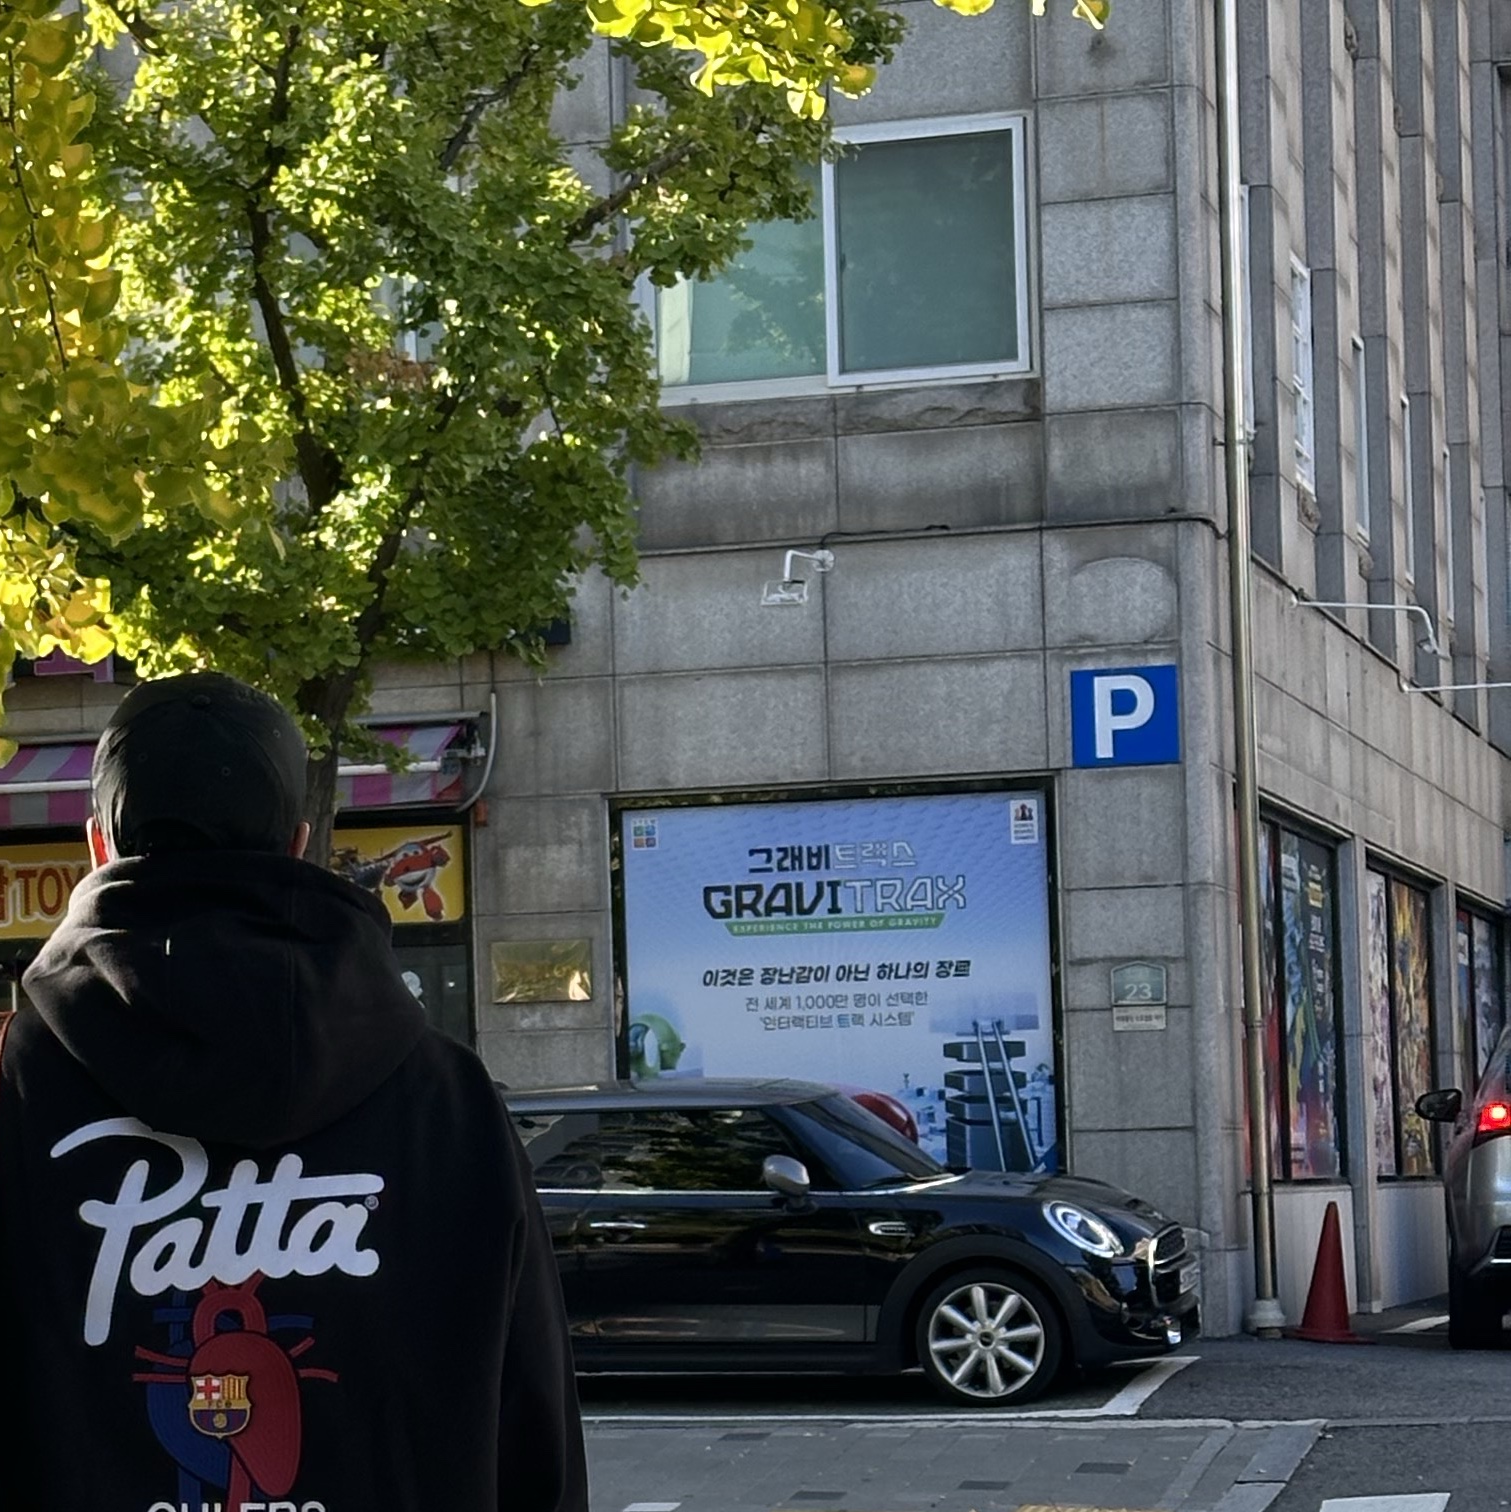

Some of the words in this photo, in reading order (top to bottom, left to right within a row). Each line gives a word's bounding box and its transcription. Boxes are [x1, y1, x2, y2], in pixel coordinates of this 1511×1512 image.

[1093, 674, 1155, 759] P
[748, 841, 917, 873] 그래비트랙스
[703, 874, 967, 919] GRAVITRAX
[732, 922, 799, 934] EXPERIENCE
[803, 920, 824, 931] THE
[827, 919, 866, 931] POWER
[869, 918, 885, 929] OF
[888, 915, 938, 928] GRAVITY
[702, 967, 755, 988] 이것은
[760, 964, 831, 986] 장난감이
[835, 963, 871, 983] 아닌
[876, 960, 930, 981] 하나의
[935, 959, 972, 979] 장르
[745, 996, 760, 1013] 전
[764, 995, 792, 1011] 세계
[853, 992, 882, 1009] 명이
[885, 990, 929, 1007] 선택한
[1124, 982, 1153, 1001] 23
[837, 1013, 865, 1029] 트랙
[50, 1116, 384, 1347] Patta
